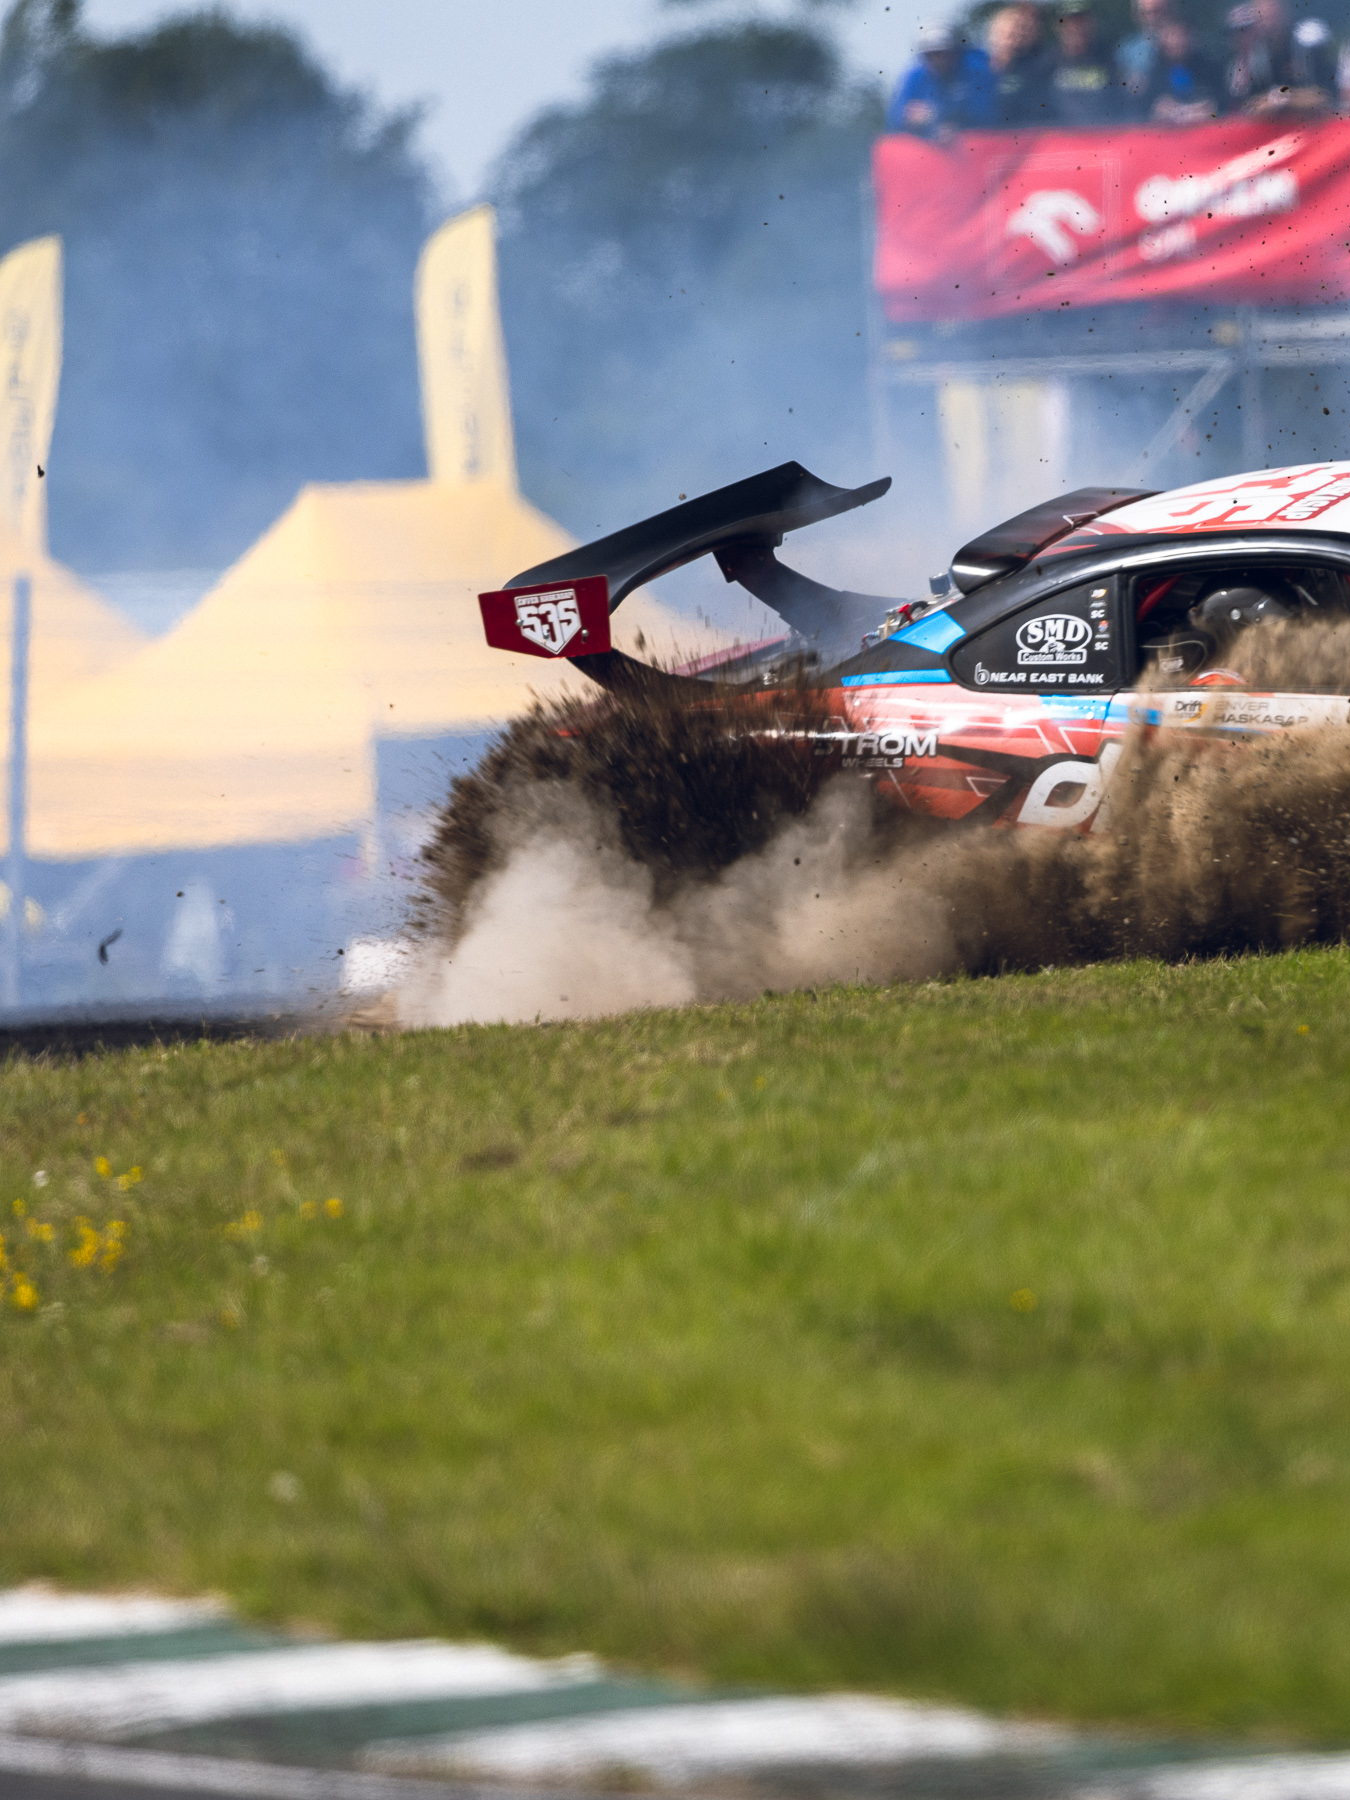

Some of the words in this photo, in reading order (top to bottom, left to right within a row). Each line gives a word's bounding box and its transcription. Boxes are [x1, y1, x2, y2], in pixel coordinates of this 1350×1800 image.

[1027, 619, 1085, 643] SMD
[1022, 652, 1054, 661] Custom
[1055, 651, 1082, 661] Works
[990, 672, 1027, 683] NEAR
[1029, 673, 1066, 683] EAST
[1068, 673, 1104, 684] BANK
[841, 757, 904, 768] WHEELS
